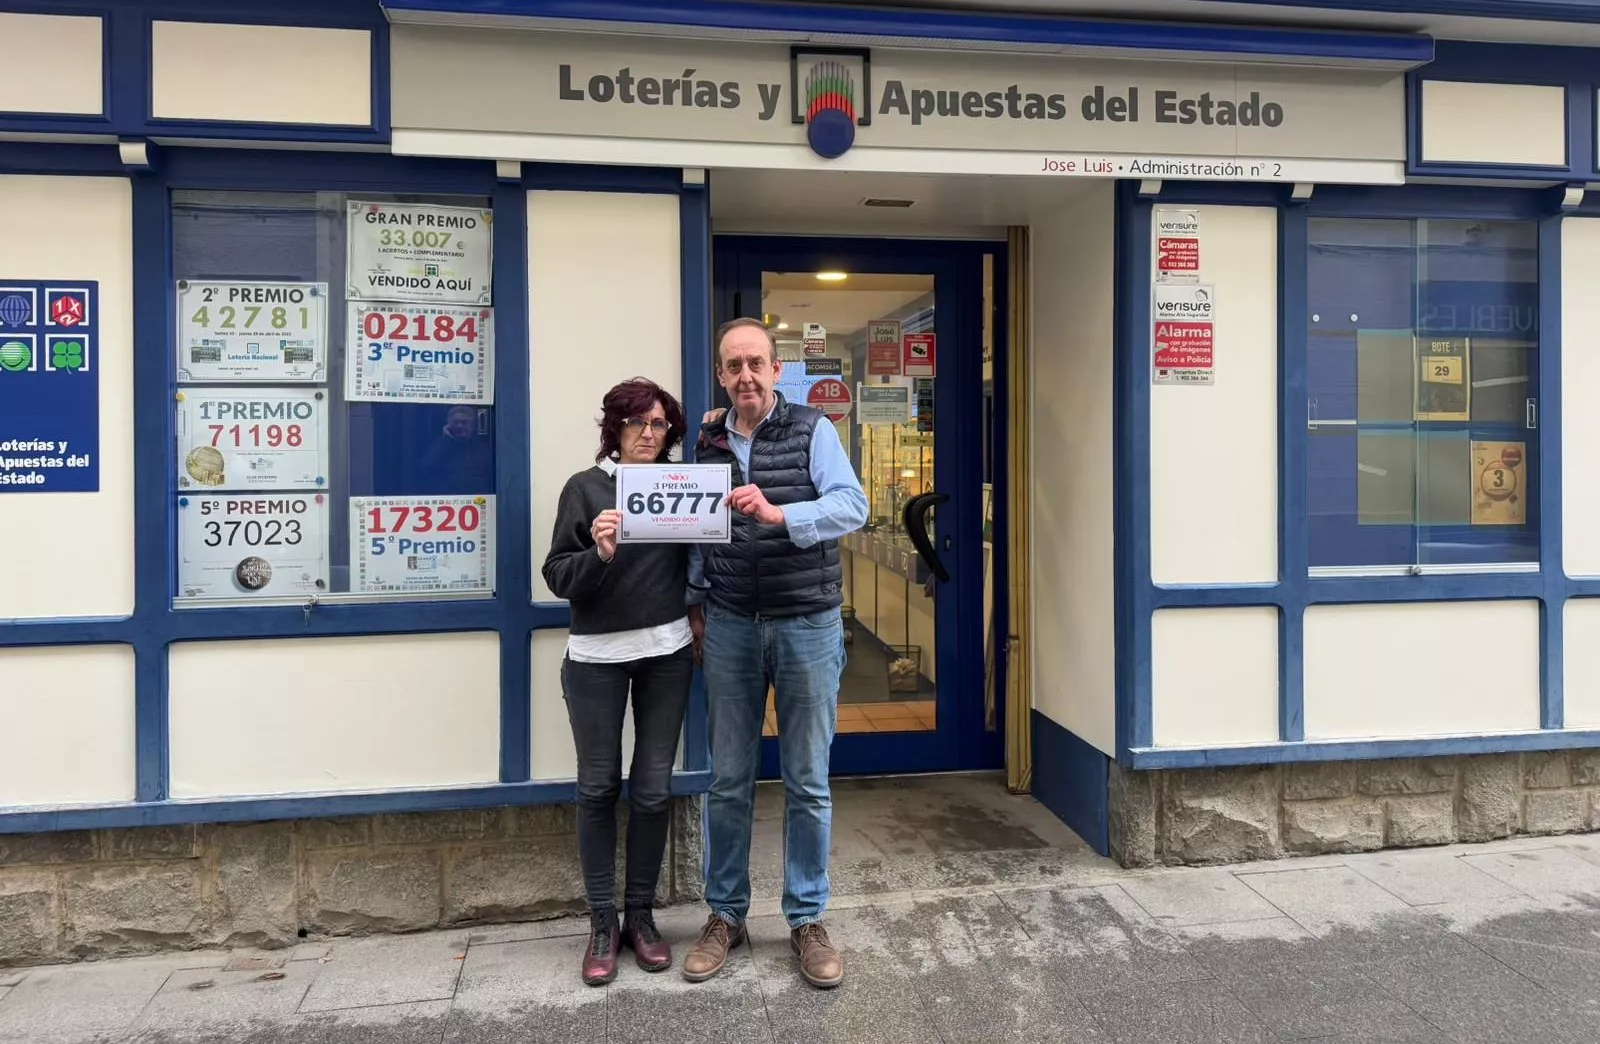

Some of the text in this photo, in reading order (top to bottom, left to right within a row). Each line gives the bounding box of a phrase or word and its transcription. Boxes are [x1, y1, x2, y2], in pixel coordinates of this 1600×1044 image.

[559, 64, 1284, 128] Loterías y Apuestas del Estado
[1041, 157, 1076, 172] Jose
[1084, 158, 1113, 173] Luis
[1129, 159, 1244, 176] Administración
[1272, 163, 1282, 178] 2
[365, 211, 477, 229] GRAN PREMIO
[1160, 222, 1198, 230] verisure
[380, 229, 452, 249] 33.007
[1160, 240, 1198, 249] Cámaras
[368, 275, 472, 291] VENDIDO AQUÍ
[229, 287, 304, 303] PREMIO
[1157, 301, 1211, 312] verisure
[363, 312, 478, 343] 02184
[1157, 324, 1212, 338] Alarma
[396, 345, 475, 365] Premio
[1431, 341, 1451, 352] BOTE
[1157, 355, 1179, 364] Aviso
[1434, 366, 1450, 376] 29
[816, 383, 841, 398] +18
[217, 401, 313, 420] PREMIO
[208, 423, 302, 447] 71198
[0, 437, 68, 454] oterías y
[66, 454, 90, 468] del
[661, 482, 698, 490] PREMIO
[1493, 469, 1504, 487] 3
[226, 500, 307, 515] PREMIO
[627, 492, 723, 515] 66777
[367, 505, 480, 533] 17320
[203, 519, 303, 547] 37023
[398, 536, 476, 554] Premio
